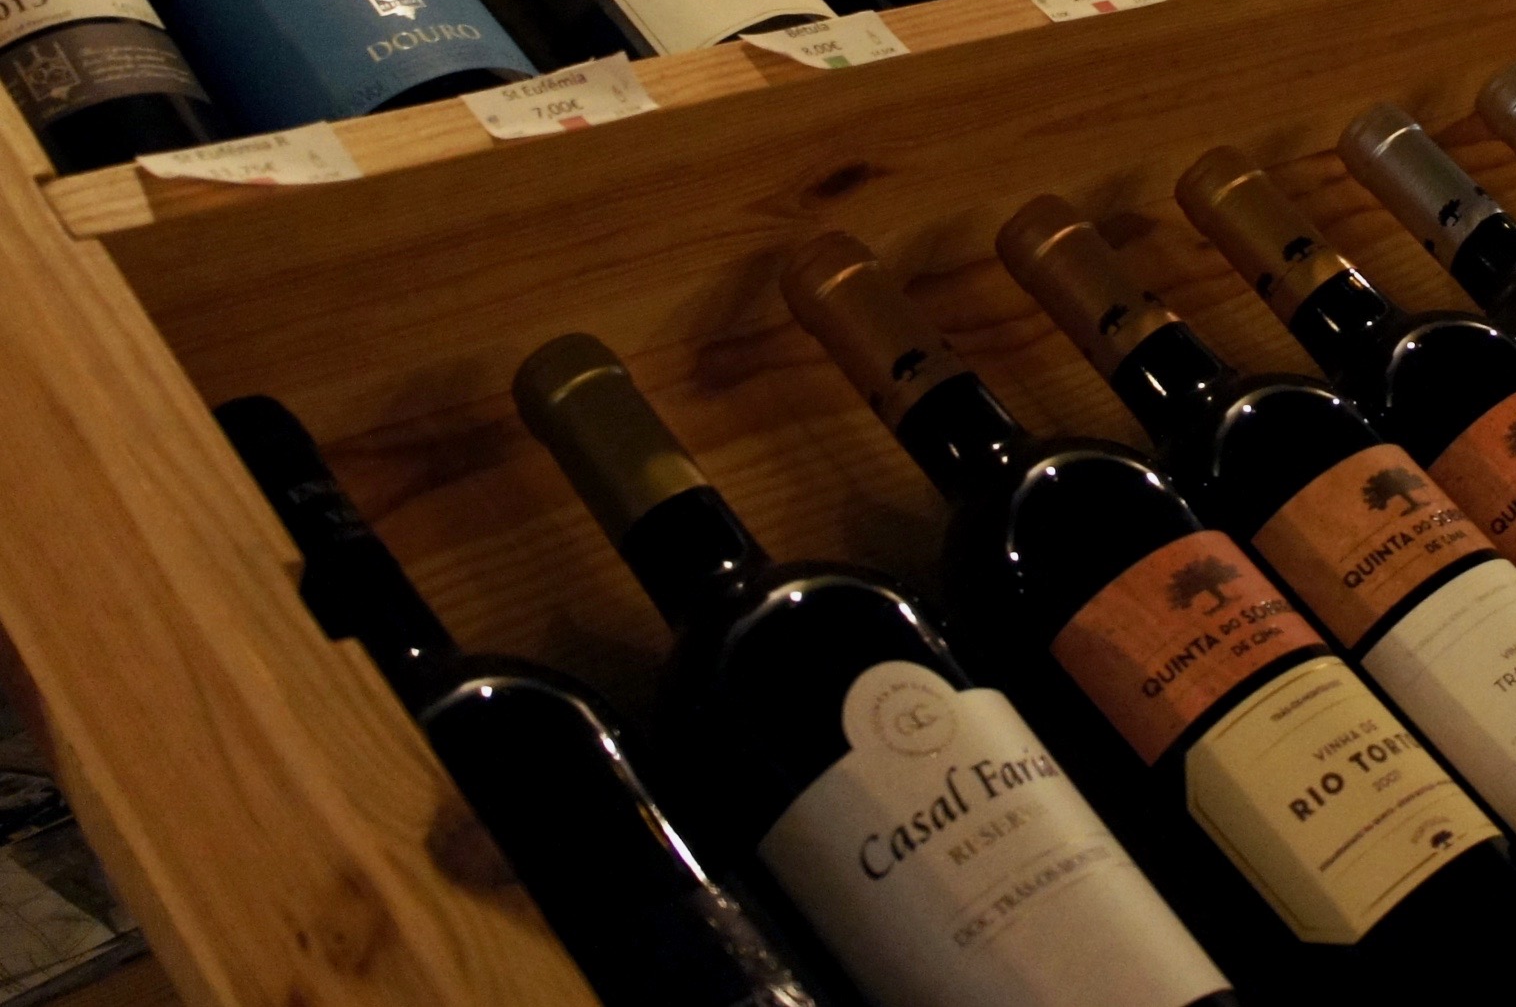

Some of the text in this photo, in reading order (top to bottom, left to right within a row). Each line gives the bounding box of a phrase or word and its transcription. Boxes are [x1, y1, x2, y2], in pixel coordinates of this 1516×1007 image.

[366, 23, 481, 63] DOURO
[1343, 519, 1432, 589] QUINTA DO
[1142, 634, 1220, 698] QUINTA
[1219, 618, 1241, 635] DO
[1314, 729, 1360, 761] VINHA
[860, 765, 969, 881] Casal
[1289, 771, 1344, 822] RIO
